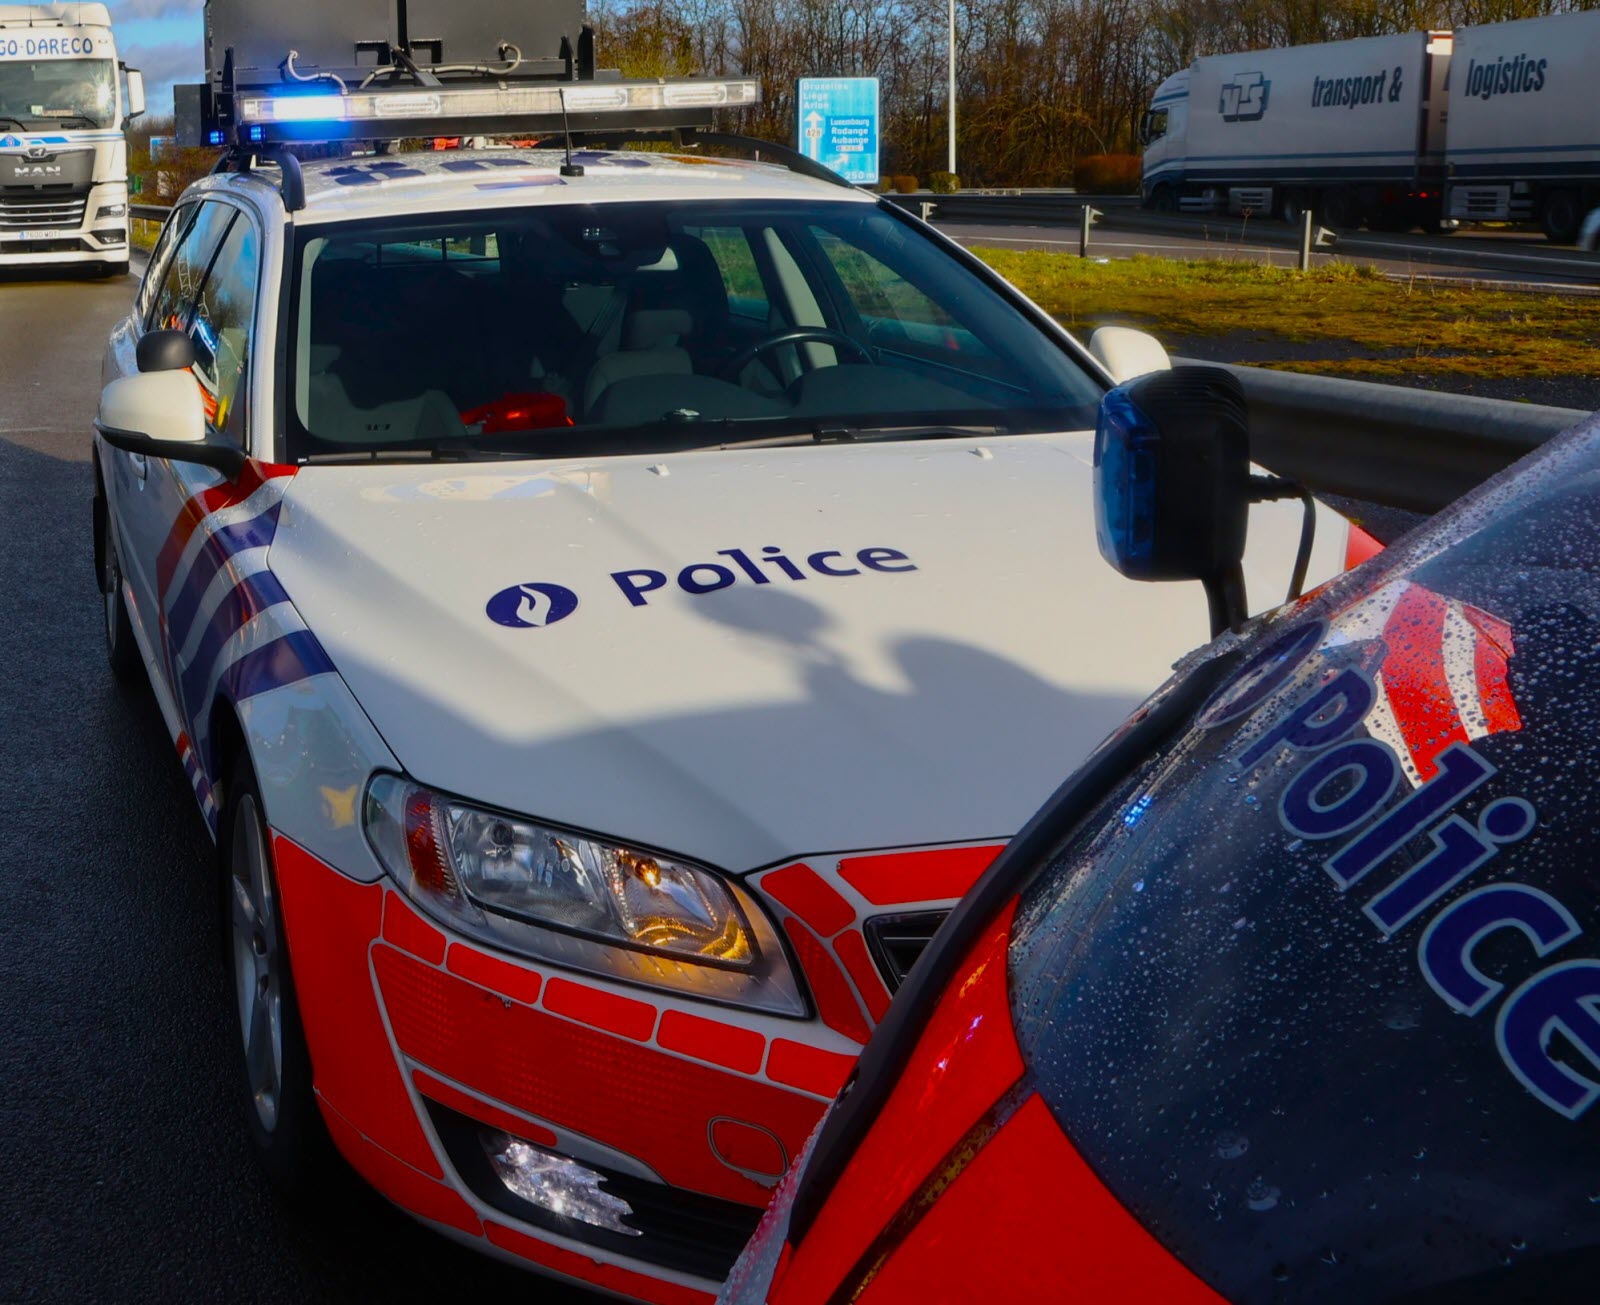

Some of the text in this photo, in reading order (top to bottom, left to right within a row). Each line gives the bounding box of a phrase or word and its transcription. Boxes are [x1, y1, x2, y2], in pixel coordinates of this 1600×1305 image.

[1464, 53, 1548, 101] logistics
[1311, 65, 1403, 110] transport &
[803, 100, 829, 110] Arlon
[831, 126, 869, 136] Rodange
[831, 136, 869, 145] Aubange
[14, 165, 62, 178] MAN
[844, 170, 875, 180] 250 m
[610, 546, 918, 607] Police
[1233, 663, 1600, 1121] Police
